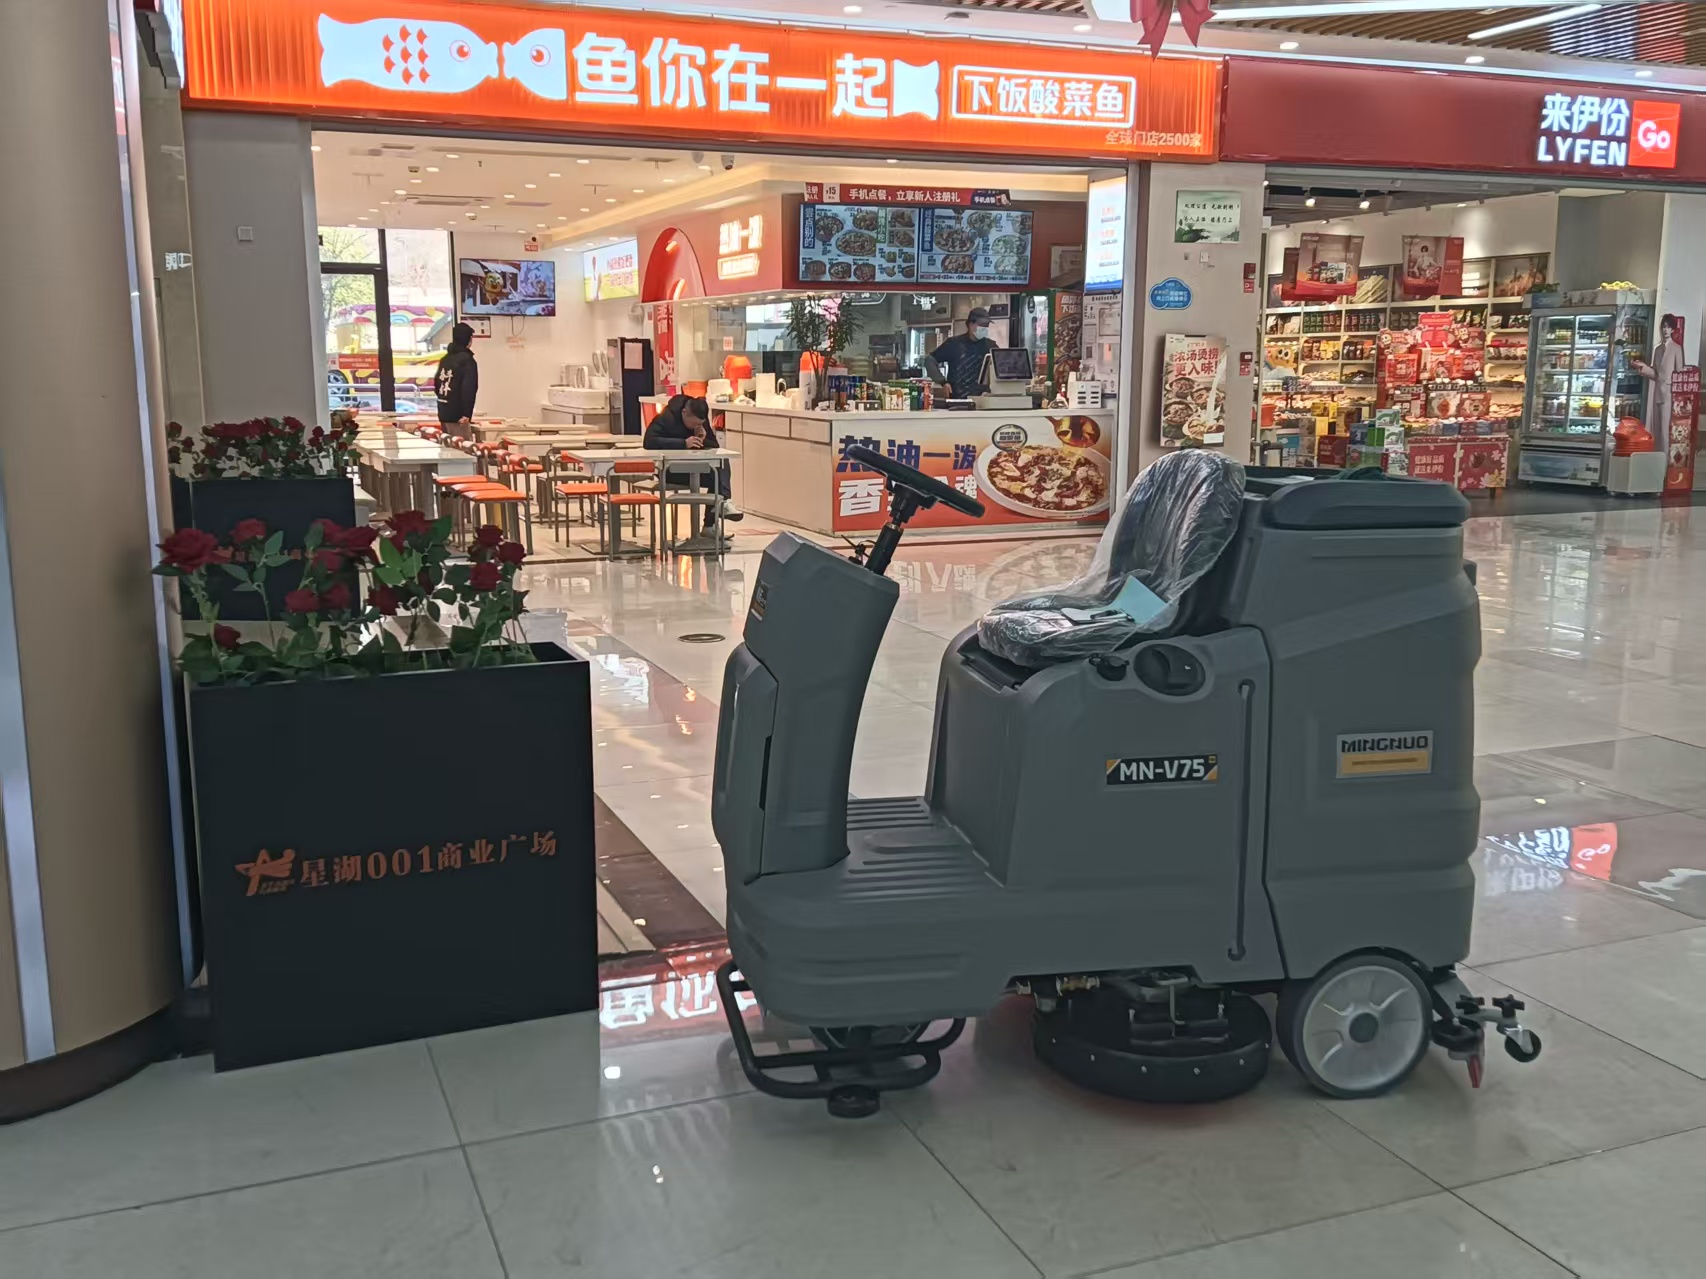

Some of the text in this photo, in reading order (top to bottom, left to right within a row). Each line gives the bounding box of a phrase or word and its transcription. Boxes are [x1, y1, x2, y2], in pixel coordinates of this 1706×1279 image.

[572, 32, 888, 118] 鱼你在一起
[963, 75, 1124, 119] 下饭酸菜鱼
[1540, 93, 1630, 136] 来伊份
[1105, 129, 1202, 147] 全球门店2500家
[1637, 120, 1671, 149] Go
[1537, 136, 1628, 166] LYFEN
[1341, 735, 1429, 753] MINGNUO
[1120, 758, 1205, 781] MN-V75
[300, 830, 557, 887] 星湖001商业广场
